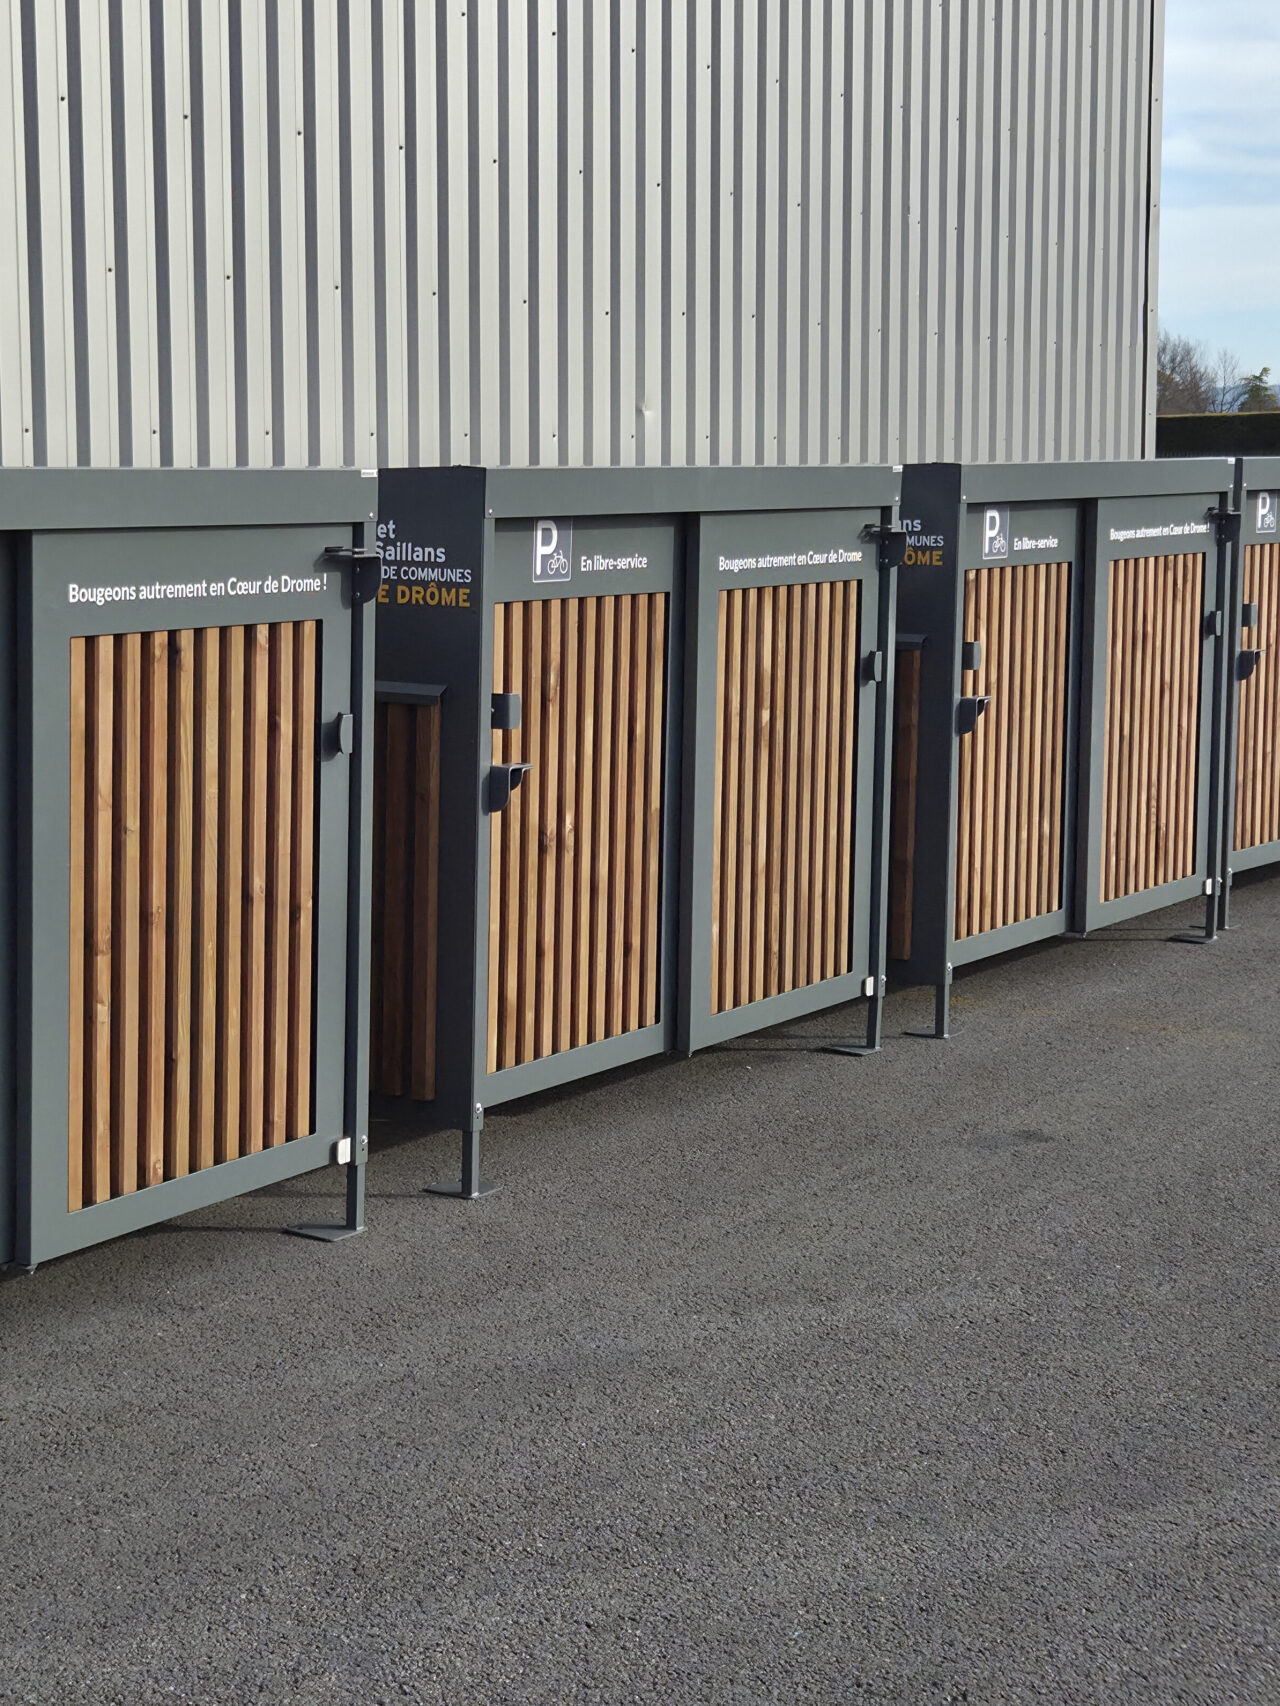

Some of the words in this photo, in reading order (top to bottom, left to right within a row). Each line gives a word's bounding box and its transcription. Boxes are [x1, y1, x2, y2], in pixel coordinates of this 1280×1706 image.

[377, 520, 396, 538] et
[907, 535, 944, 547] MUNES
[376, 541, 446, 563] Saillans
[719, 556, 756, 573] Bougeons
[758, 554, 796, 568] autrement
[797, 555, 807, 566] en
[828, 549, 838, 564] de
[904, 547, 943, 566] ÔME
[580, 556, 592, 572] En
[594, 553, 648, 571] libre-service
[382, 565, 398, 579] DE
[400, 566, 472, 583] COMMUNES
[68, 583, 136, 606] Bougeons
[139, 580, 207, 600] autrement
[209, 582, 225, 596] en
[227, 577, 261, 596] Cœur
[263, 575, 279, 594] de
[281, 575, 321, 593] Drome
[377, 584, 390, 603] E
[397, 582, 471, 607] DRÔME
